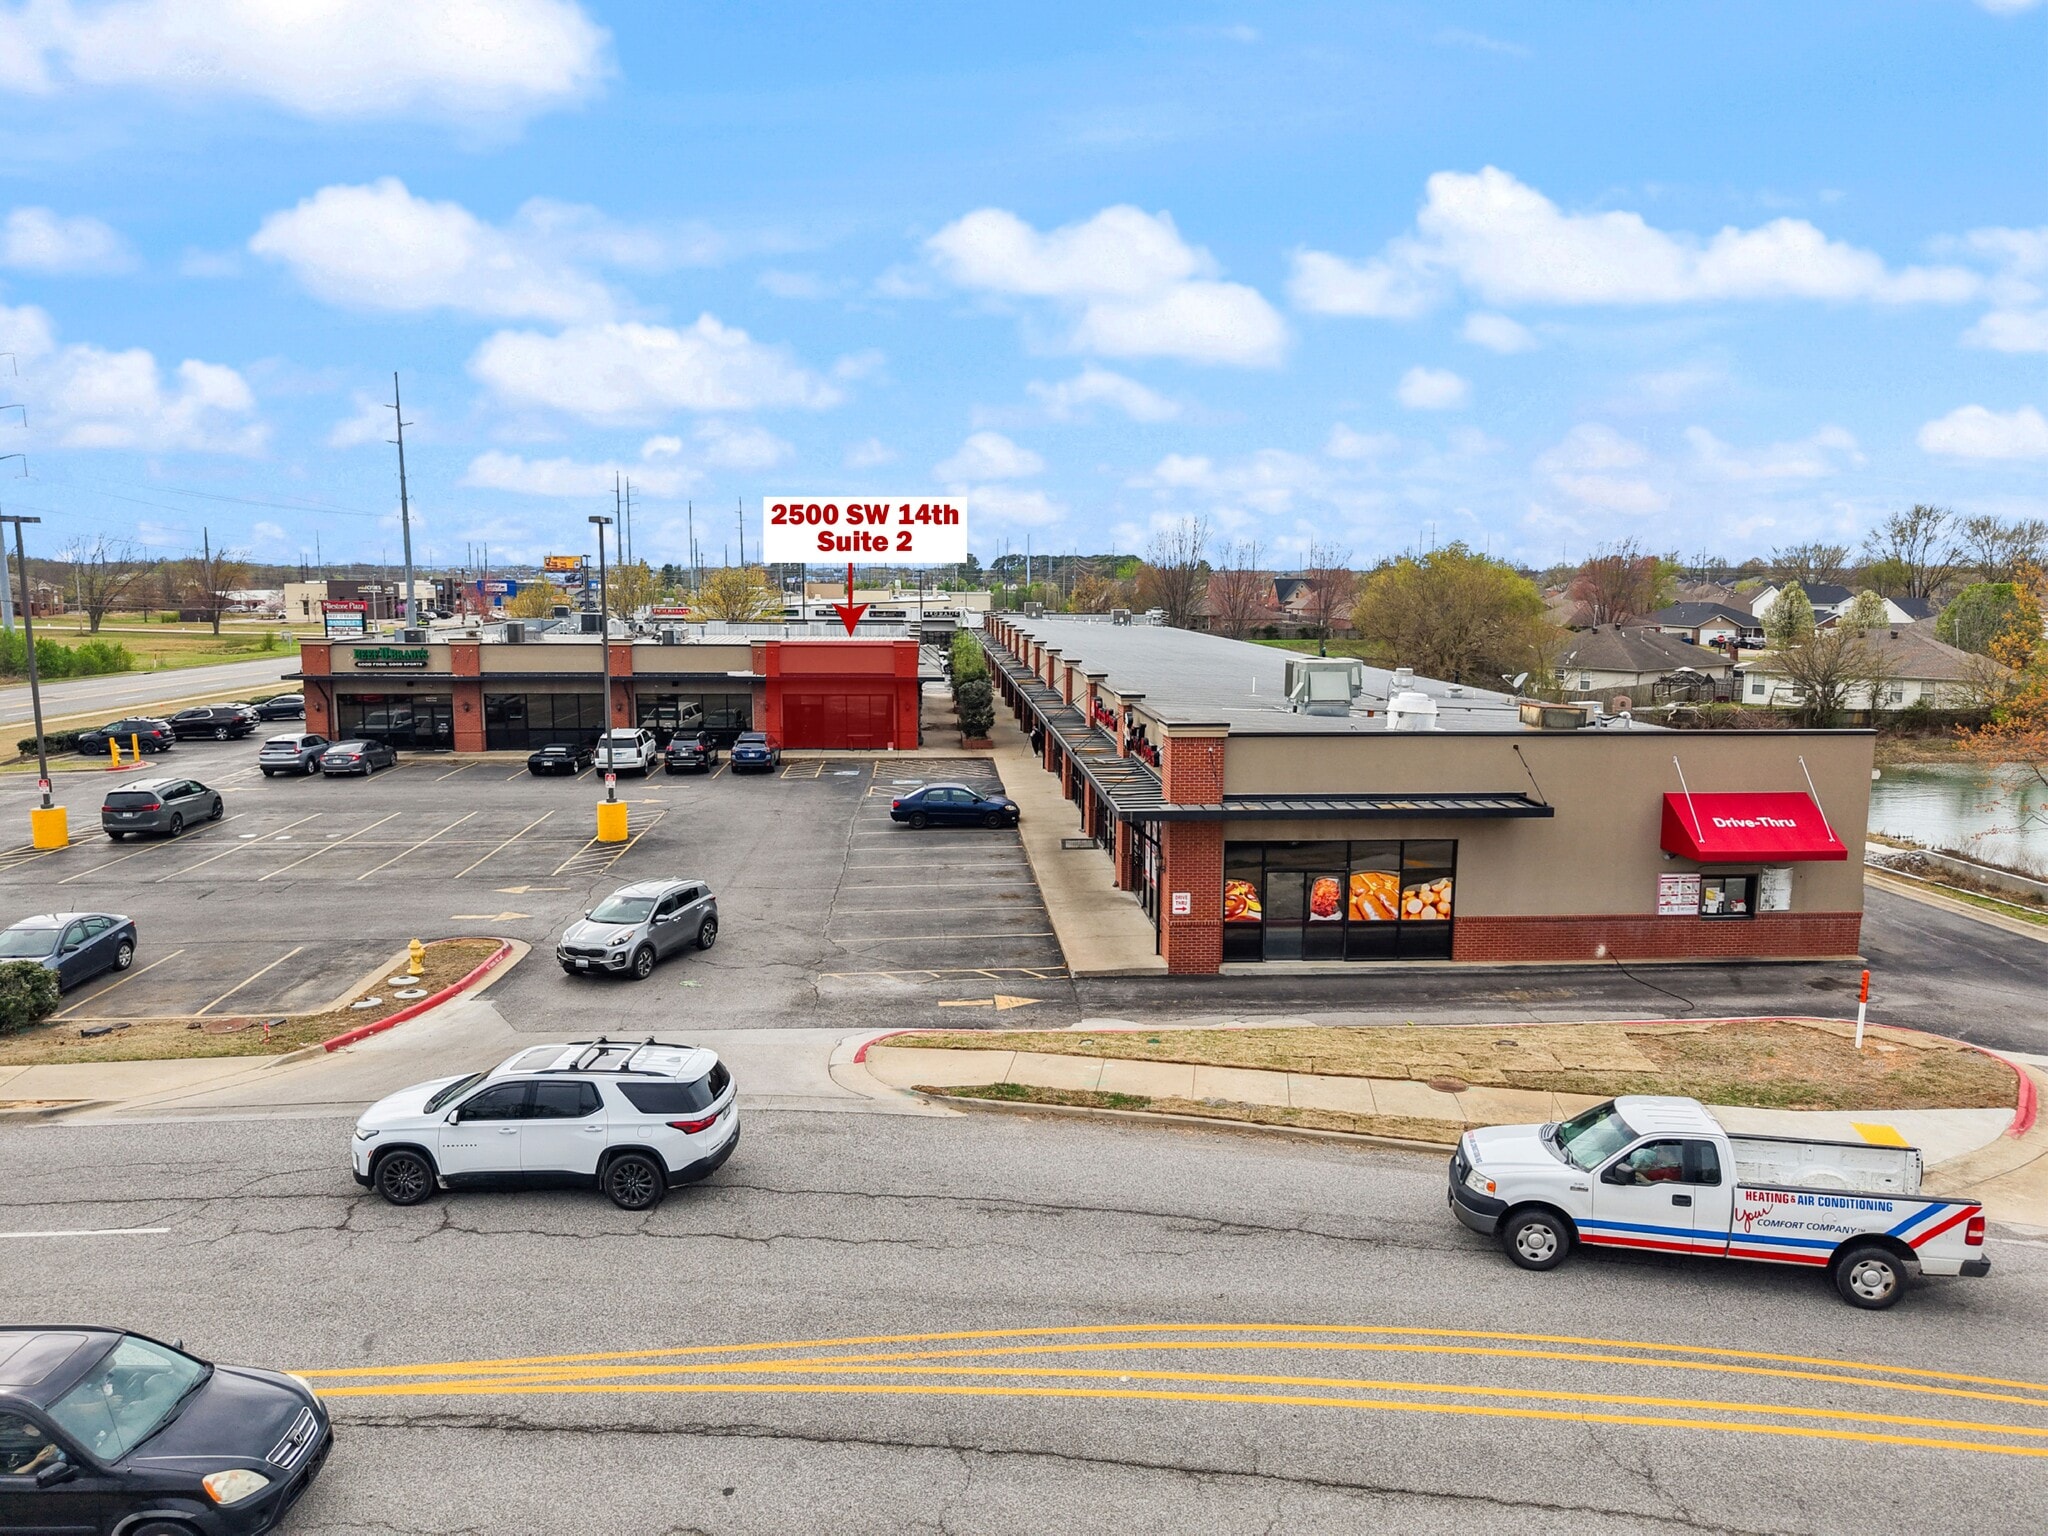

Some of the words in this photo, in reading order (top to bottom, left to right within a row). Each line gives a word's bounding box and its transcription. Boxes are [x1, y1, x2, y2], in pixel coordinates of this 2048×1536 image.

[323, 602, 348, 610] Milestone
[349, 601, 364, 610] Plaza
[353, 649, 379, 660] BEEF
[1712, 816, 1797, 828] Drive-Thru
[1745, 1191, 1789, 1204] HEATING
[1790, 1195, 1796, 1203] &
[1797, 1195, 1815, 1206] AIR
[1818, 1198, 1893, 1212] CONDITIONING
[1735, 1204, 1773, 1233] Your
[1757, 1219, 1804, 1229] COMFORT
[1806, 1223, 1857, 1234] COMPANY
